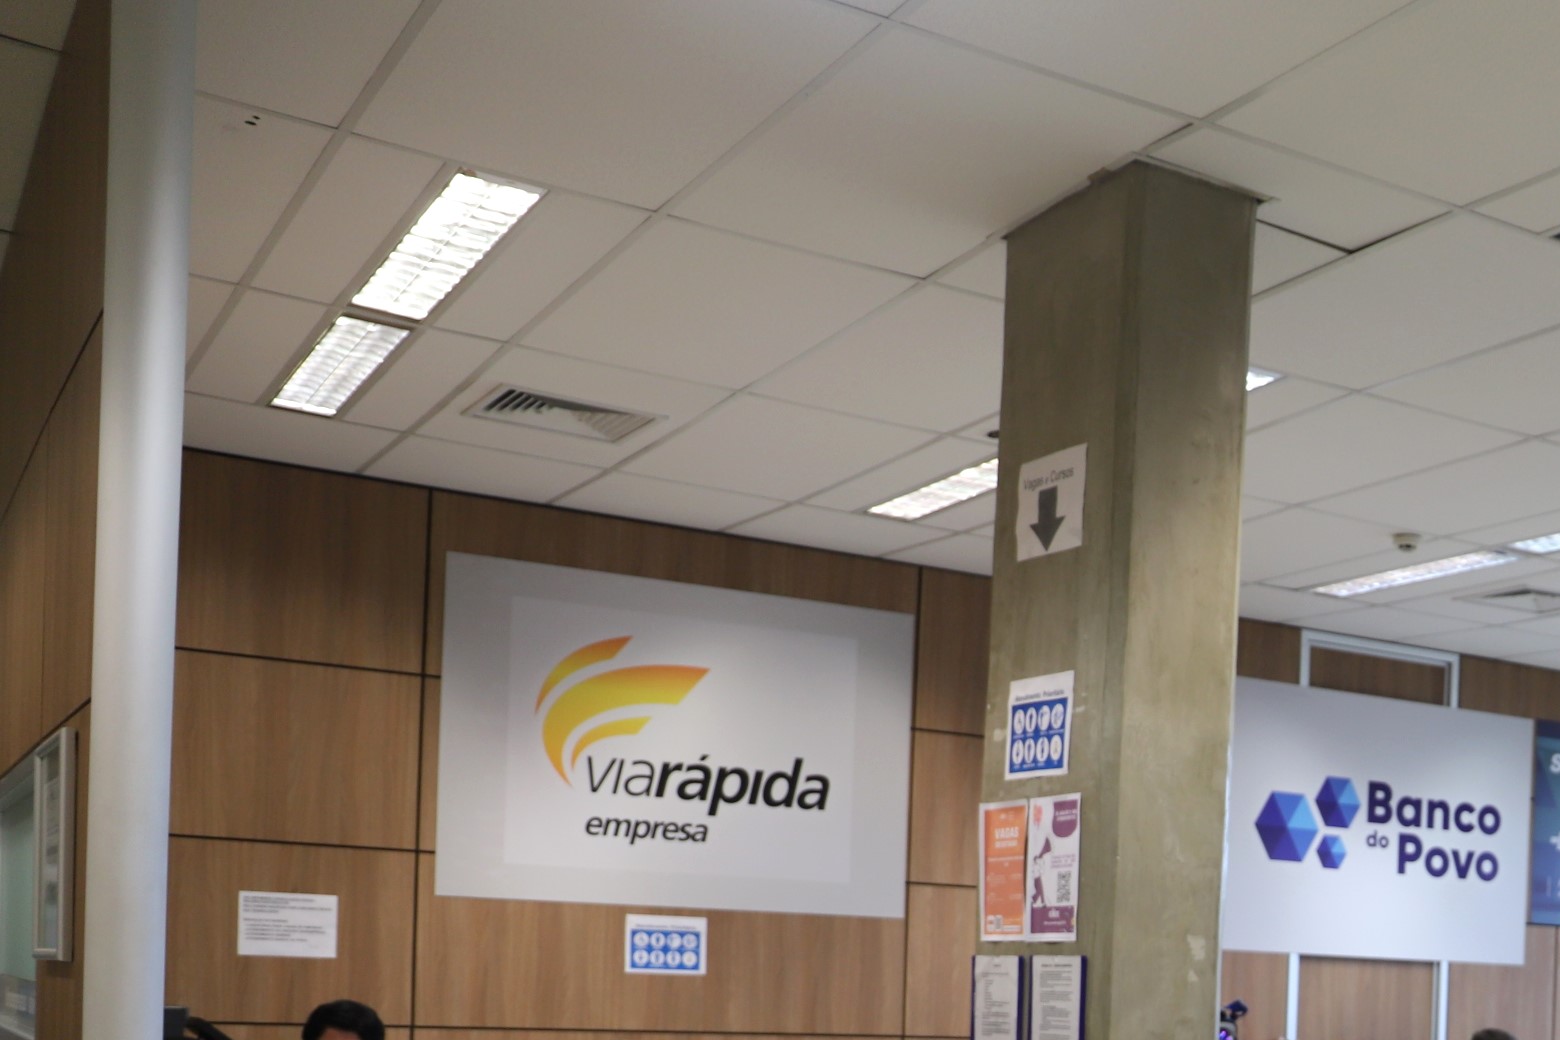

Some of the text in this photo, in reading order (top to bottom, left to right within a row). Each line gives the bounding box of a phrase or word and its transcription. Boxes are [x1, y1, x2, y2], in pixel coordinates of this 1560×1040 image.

[1367, 780, 1501, 835] Banco
[585, 816, 709, 845] empresa
[1366, 829, 1389, 848] do
[1398, 832, 1499, 881] Povo
